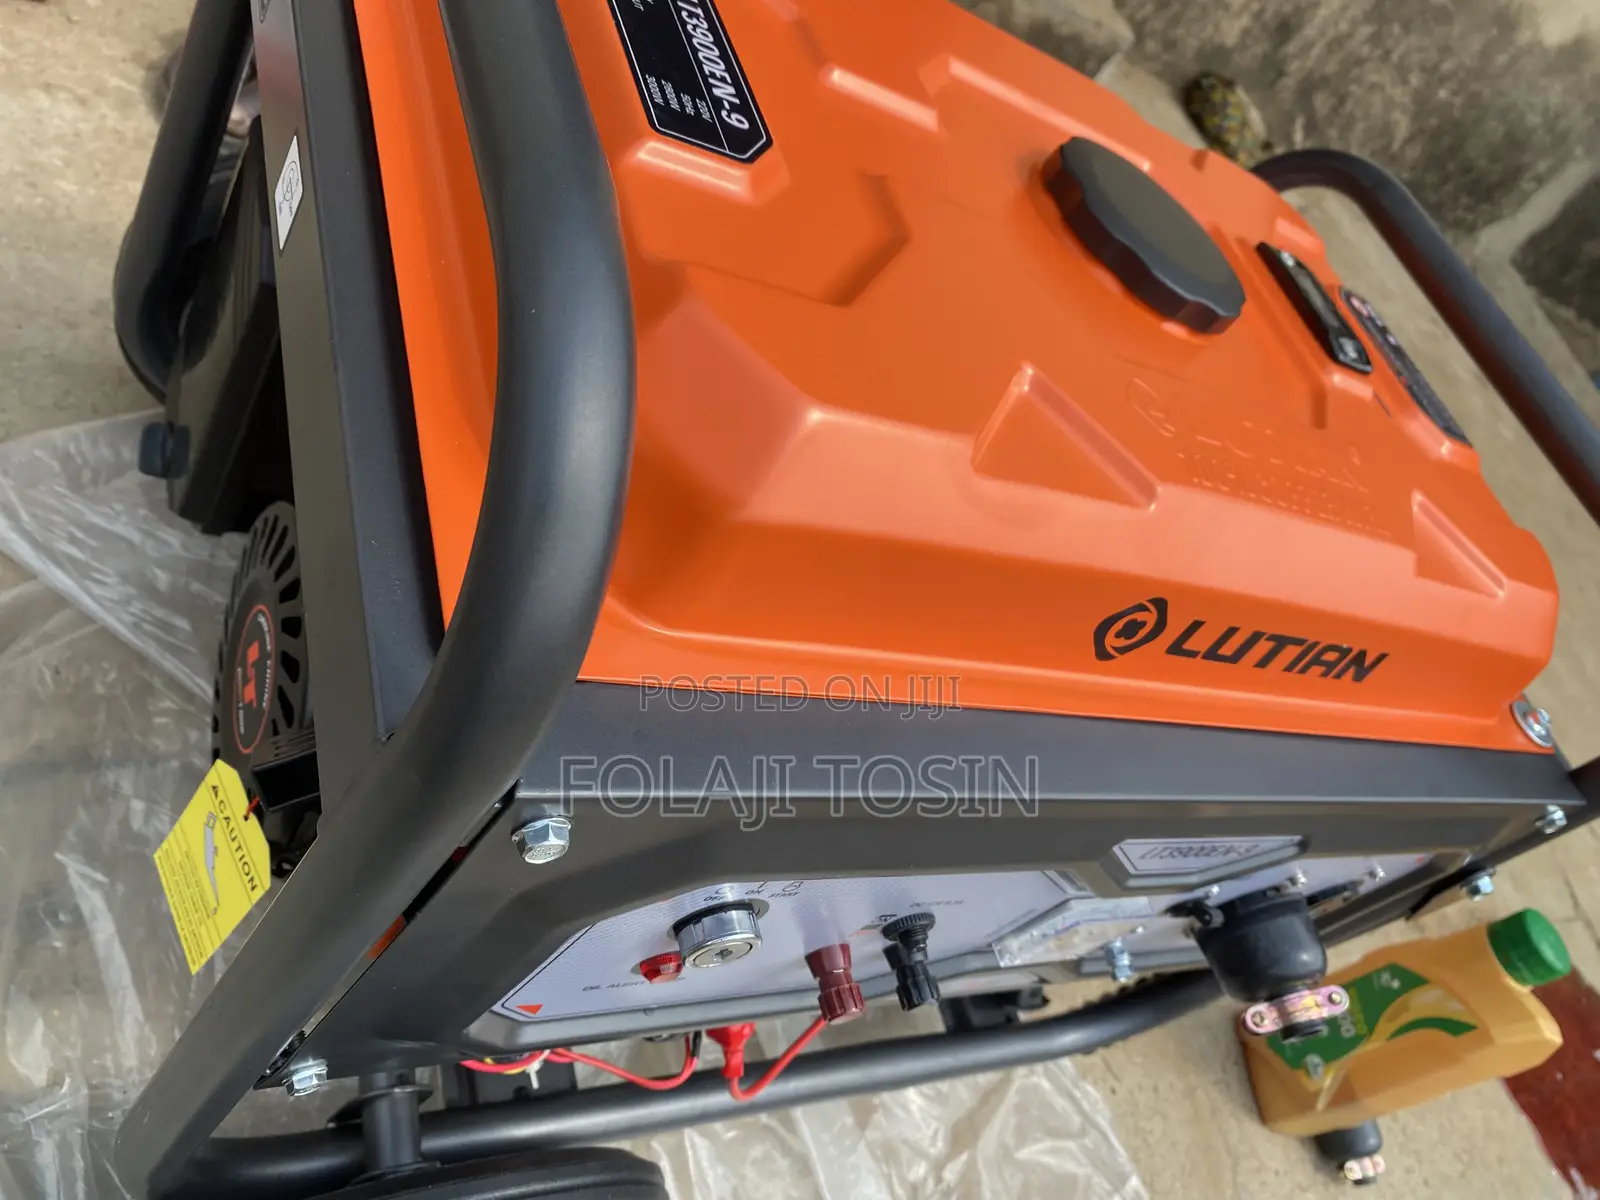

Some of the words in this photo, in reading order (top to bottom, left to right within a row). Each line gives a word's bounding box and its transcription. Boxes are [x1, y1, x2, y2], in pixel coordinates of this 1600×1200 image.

[645, 73, 665, 106] 3000W
[677, 0, 750, 130] T3900EN-9
[1164, 618, 1390, 684] LUTIAN
[218, 799, 258, 892] CAUTION
[744, 888, 765, 896] ON
